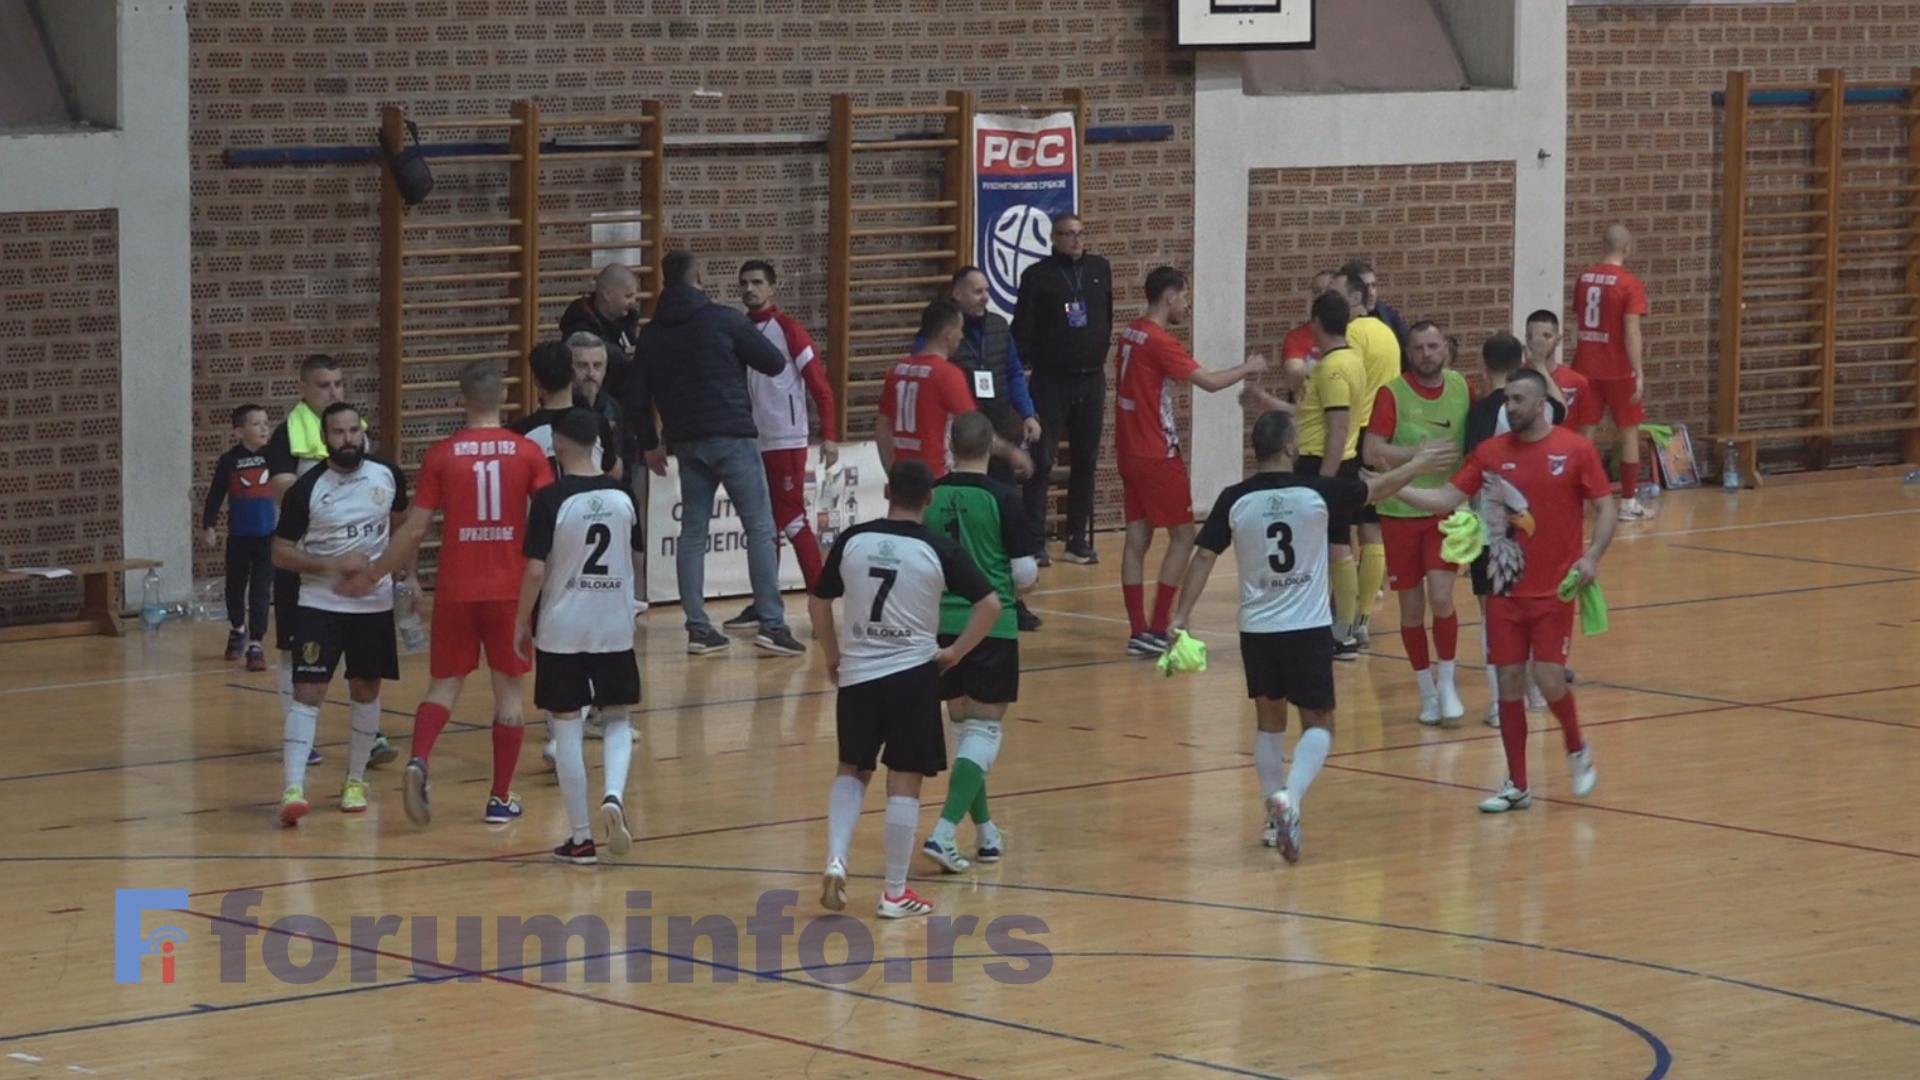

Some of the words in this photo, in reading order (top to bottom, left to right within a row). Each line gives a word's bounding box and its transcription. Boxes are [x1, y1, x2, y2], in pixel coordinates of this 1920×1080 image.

[983, 135, 1065, 168] РСС
[1584, 286, 1601, 328] 8
[895, 380, 919, 433] 10
[472, 459, 501, 521] 11
[582, 522, 612, 575] 2
[1266, 521, 1295, 574] 3
[579, 580, 623, 590] BLOKAR
[868, 566, 898, 622] 7
[867, 627, 912, 638] BLOKAR
